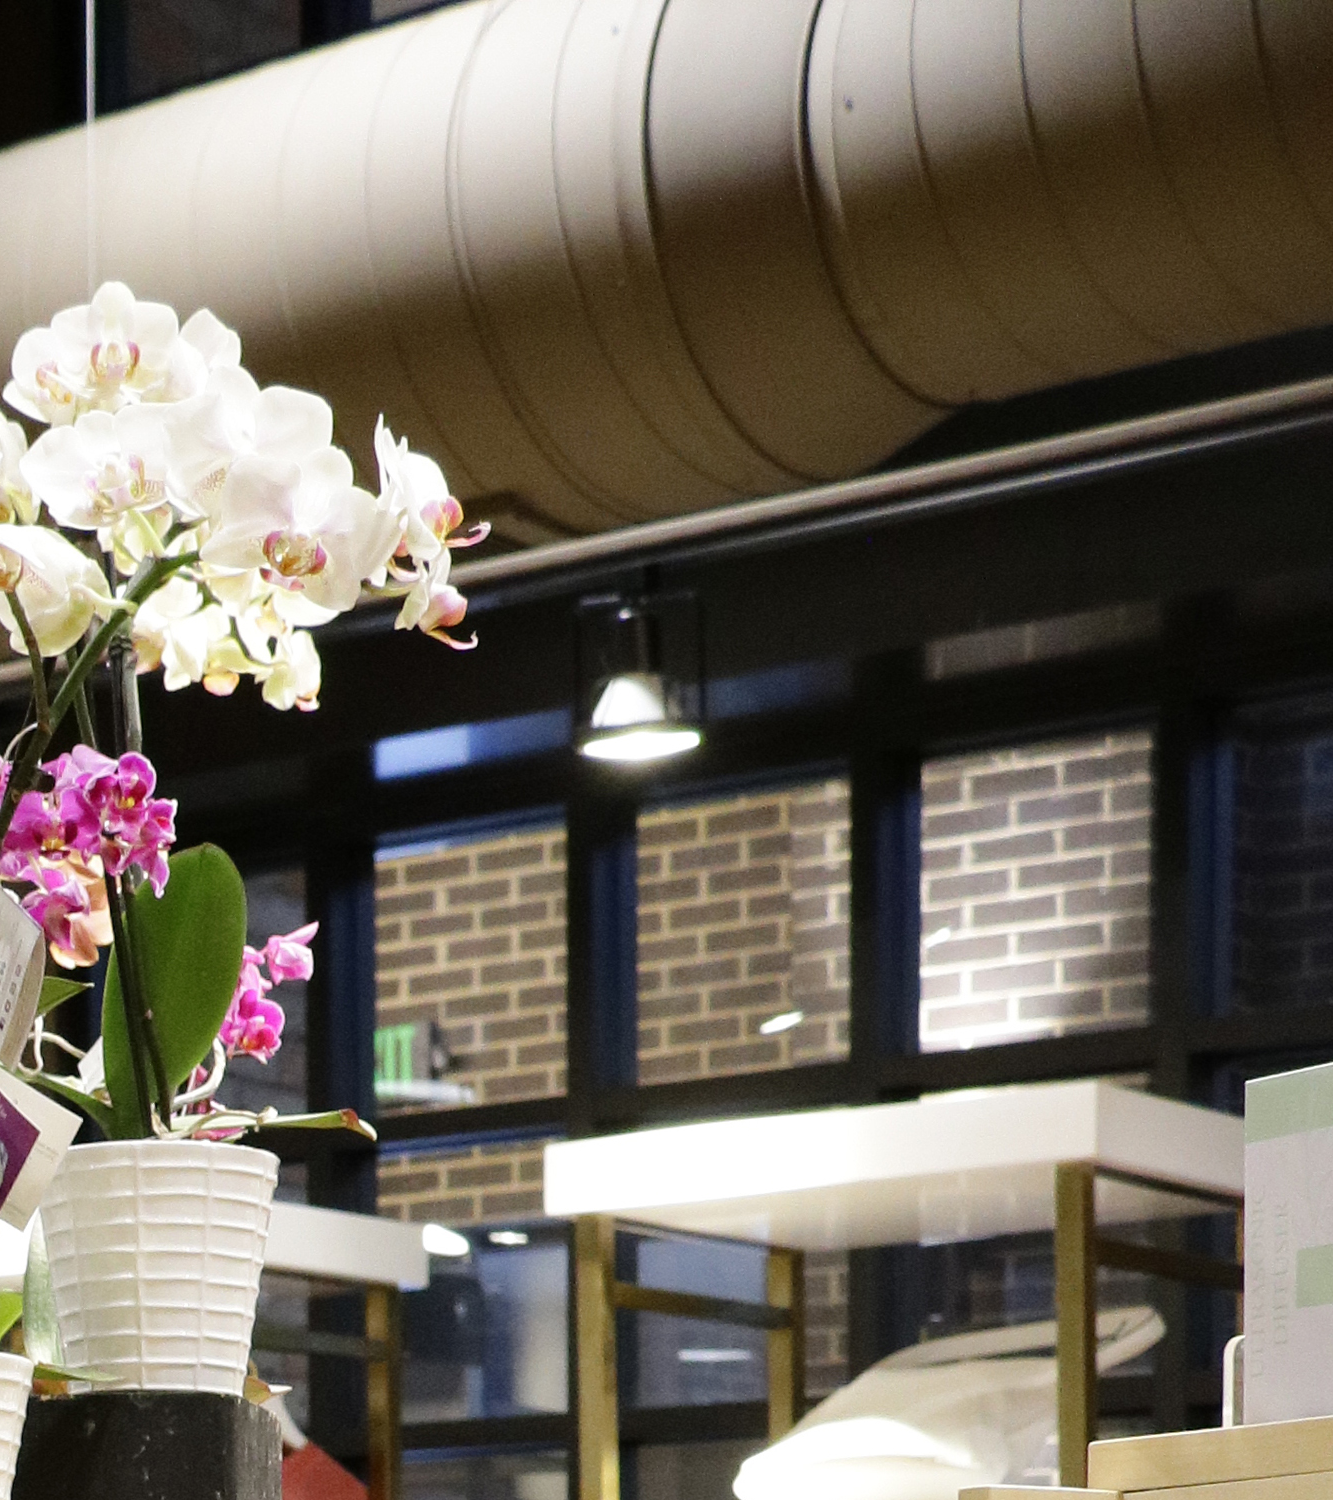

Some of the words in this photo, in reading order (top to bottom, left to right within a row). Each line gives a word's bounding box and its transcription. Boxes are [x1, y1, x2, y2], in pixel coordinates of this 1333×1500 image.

[374, 1024, 415, 1084] IT
[1250, 1185, 1265, 1378] ULTRASONIC
[1271, 1200, 1288, 1346] DIFFUSER
